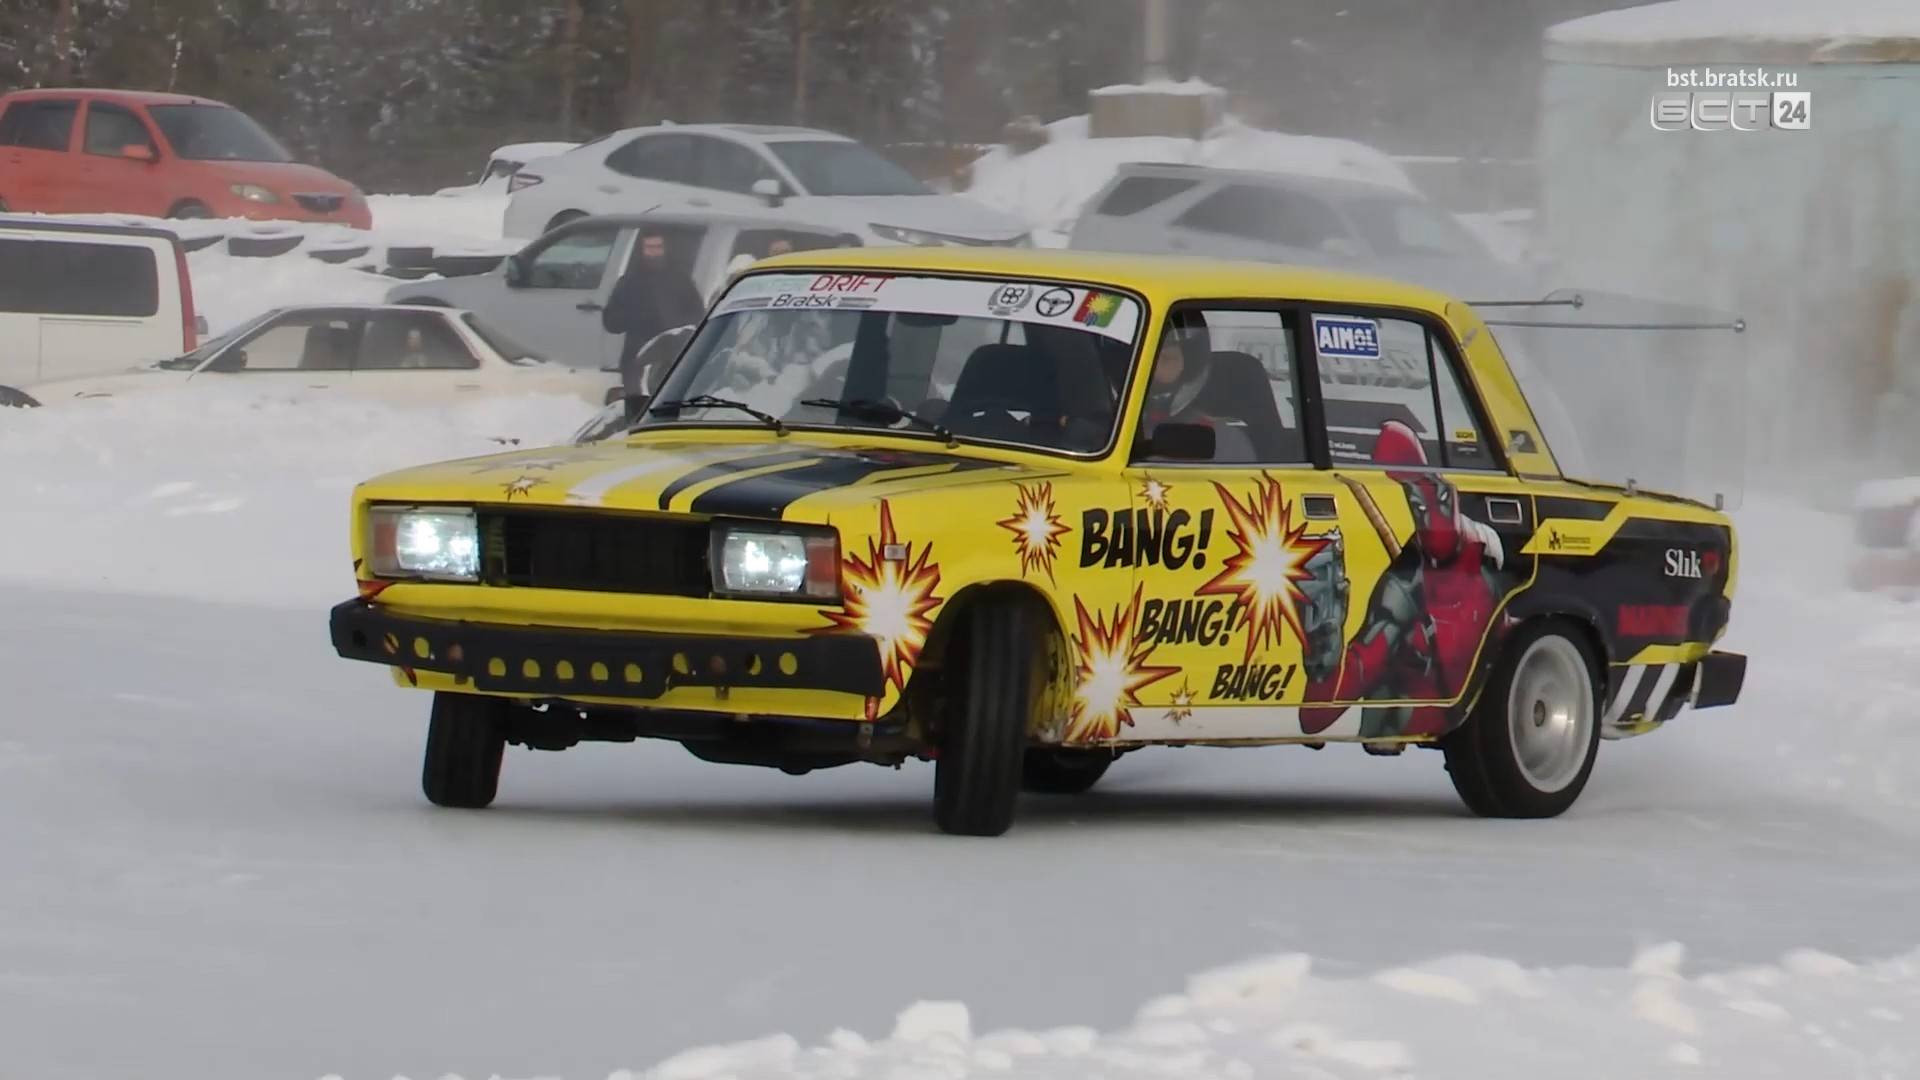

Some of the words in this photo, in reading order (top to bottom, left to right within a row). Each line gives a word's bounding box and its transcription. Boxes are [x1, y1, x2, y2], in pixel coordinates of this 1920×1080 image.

[810, 274, 896, 293] DRIFT
[772, 293, 836, 308] Bratsk
[1319, 326, 1378, 350] AIMOL
[1079, 508, 1214, 570] BANG!
[1664, 548, 1702, 578] Slik
[1137, 598, 1240, 646] BANG!
[1209, 663, 1297, 701] BANG!
